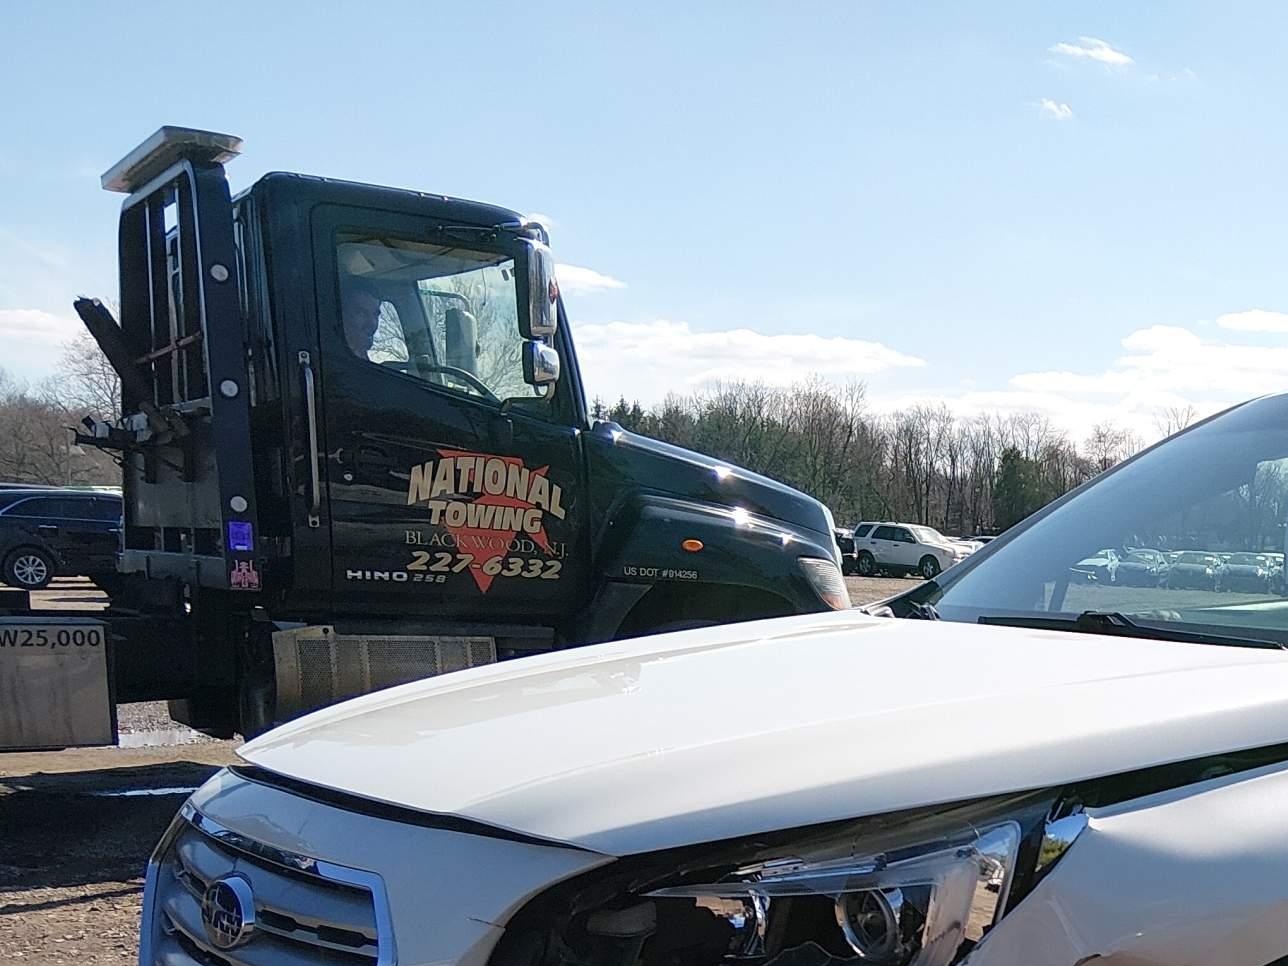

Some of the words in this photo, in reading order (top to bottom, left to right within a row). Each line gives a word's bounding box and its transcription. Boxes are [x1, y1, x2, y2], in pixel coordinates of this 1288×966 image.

[407, 456, 567, 521] NATIONAL
[428, 500, 544, 534] TOWING
[346, 569, 408, 582] HINO
[412, 573, 447, 583] 258
[406, 550, 562, 580] 227-6332
[623, 566, 637, 576] US
[640, 567, 659, 577] DOT
[0, 629, 100, 649] W25,000
